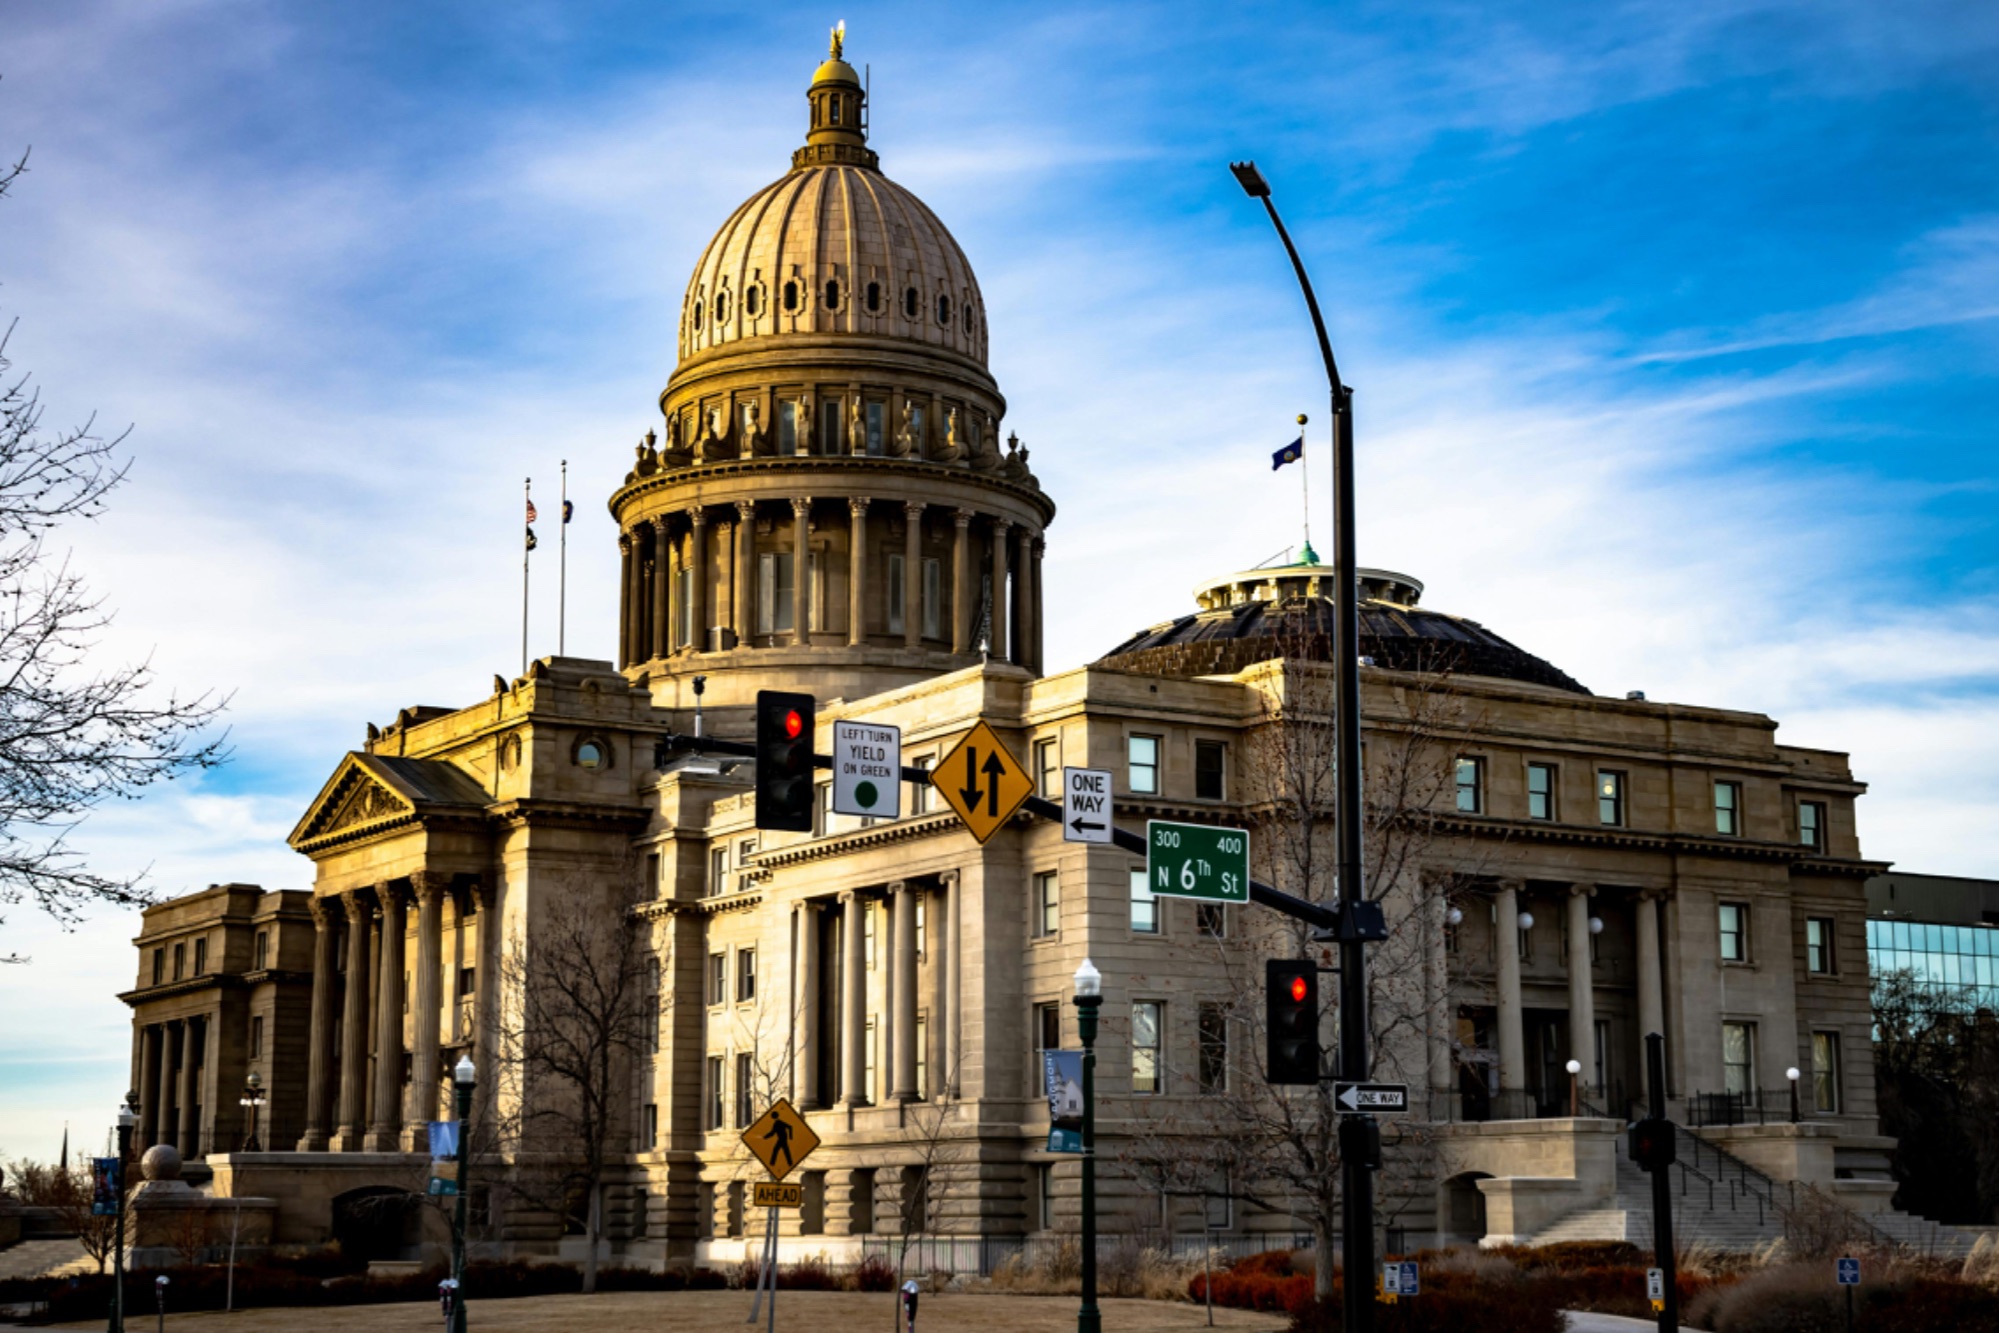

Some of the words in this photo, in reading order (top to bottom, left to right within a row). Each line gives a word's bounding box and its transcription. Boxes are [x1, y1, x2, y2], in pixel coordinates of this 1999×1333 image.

[842, 728, 864, 740] LEFT
[867, 730, 892, 743] TURN
[850, 744, 885, 762] YIELD
[843, 762, 857, 775] ON
[860, 764, 891, 778] GREEN
[1072, 773, 1105, 793] ONE
[1072, 794, 1105, 813] WAY
[1155, 830, 1180, 848] 300
[1216, 836, 1242, 854] 400
[1158, 866, 1169, 887] N
[1221, 871, 1239, 893] St
[1357, 1092, 1377, 1104] ONE
[1380, 1093, 1400, 1104] WAY
[758, 1188, 798, 1202] AHEAD
